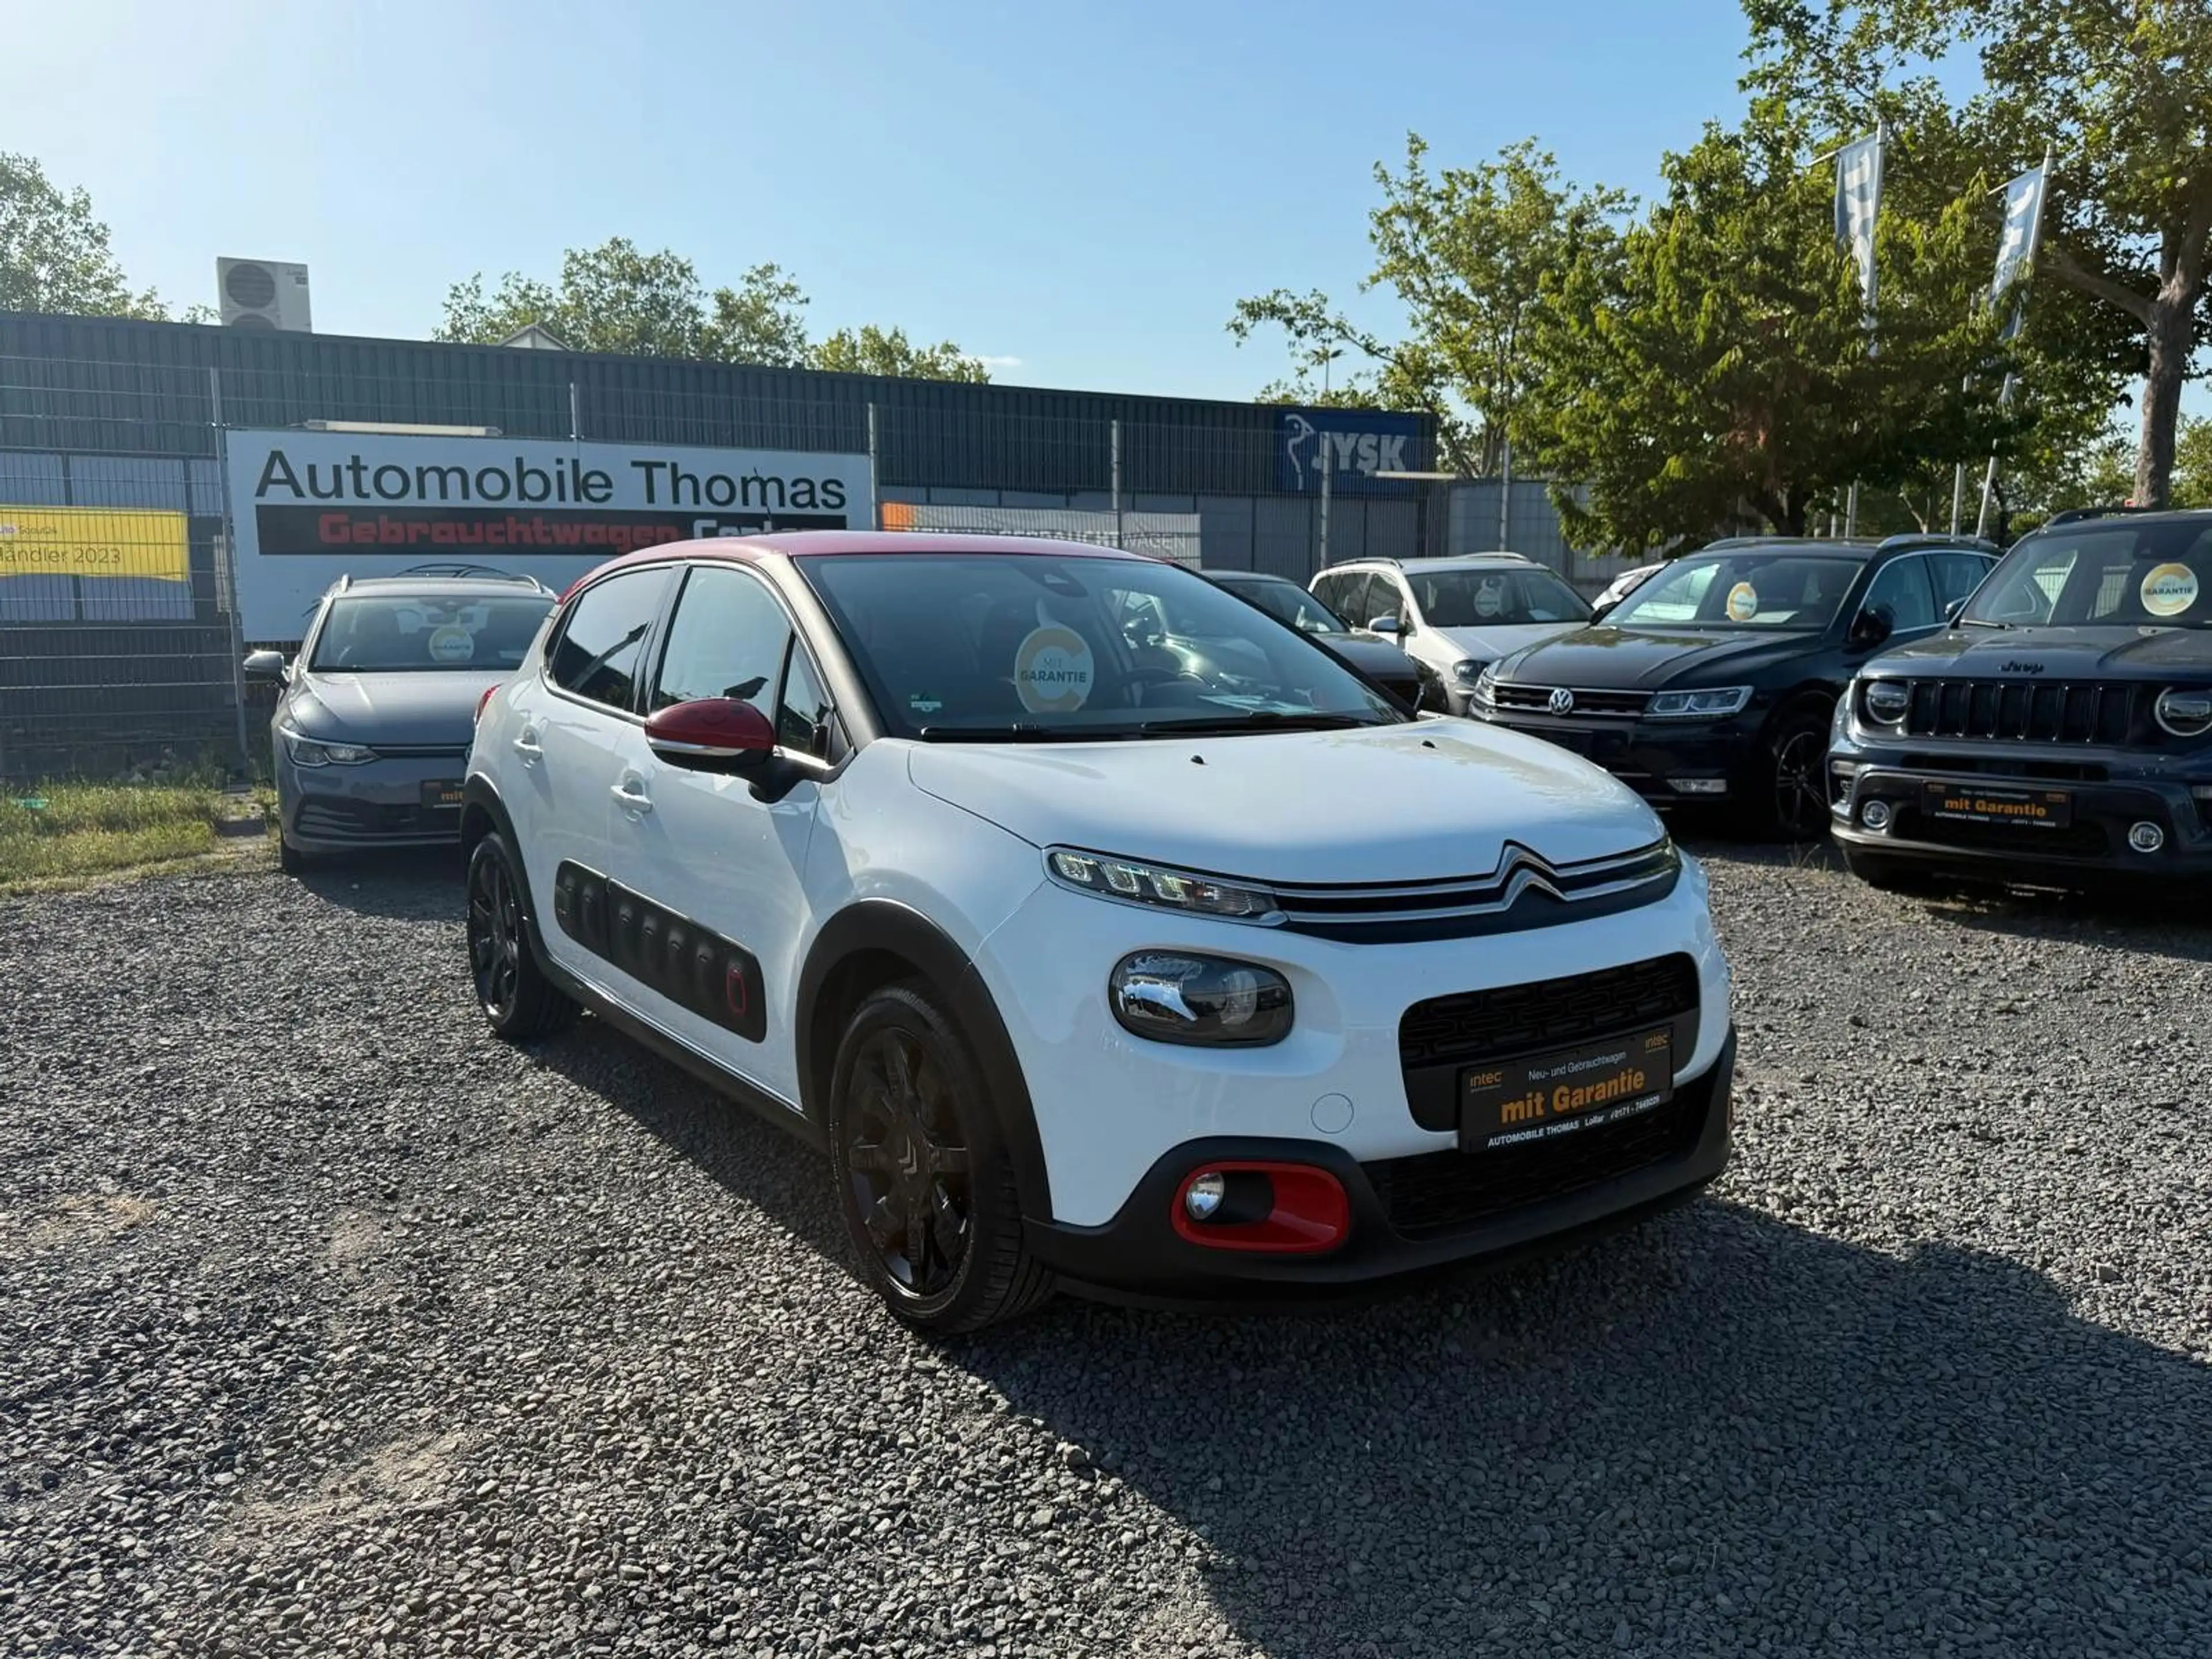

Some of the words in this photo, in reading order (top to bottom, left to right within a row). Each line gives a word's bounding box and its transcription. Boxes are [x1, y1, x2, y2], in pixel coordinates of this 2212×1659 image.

[1311, 432, 1407, 472] JYSK
[255, 450, 613, 503] Automobile
[631, 460, 846, 509] Thomas
[319, 514, 679, 554] Gebrauchtwagen
[74, 548, 120, 563] 2023
[1020, 669, 1087, 683] GARANTIE
[1945, 798, 1971, 810] mit
[1975, 799, 2047, 817] Garantie
[1528, 1070, 1550, 1081] Neu-
[1551, 1065, 1566, 1077] und
[1501, 1091, 1546, 1124] mit
[1552, 1067, 1646, 1112] Garantie
[1487, 1127, 1545, 1149] AUTOMOBILE
[1546, 1120, 1580, 1135] THOMAS
